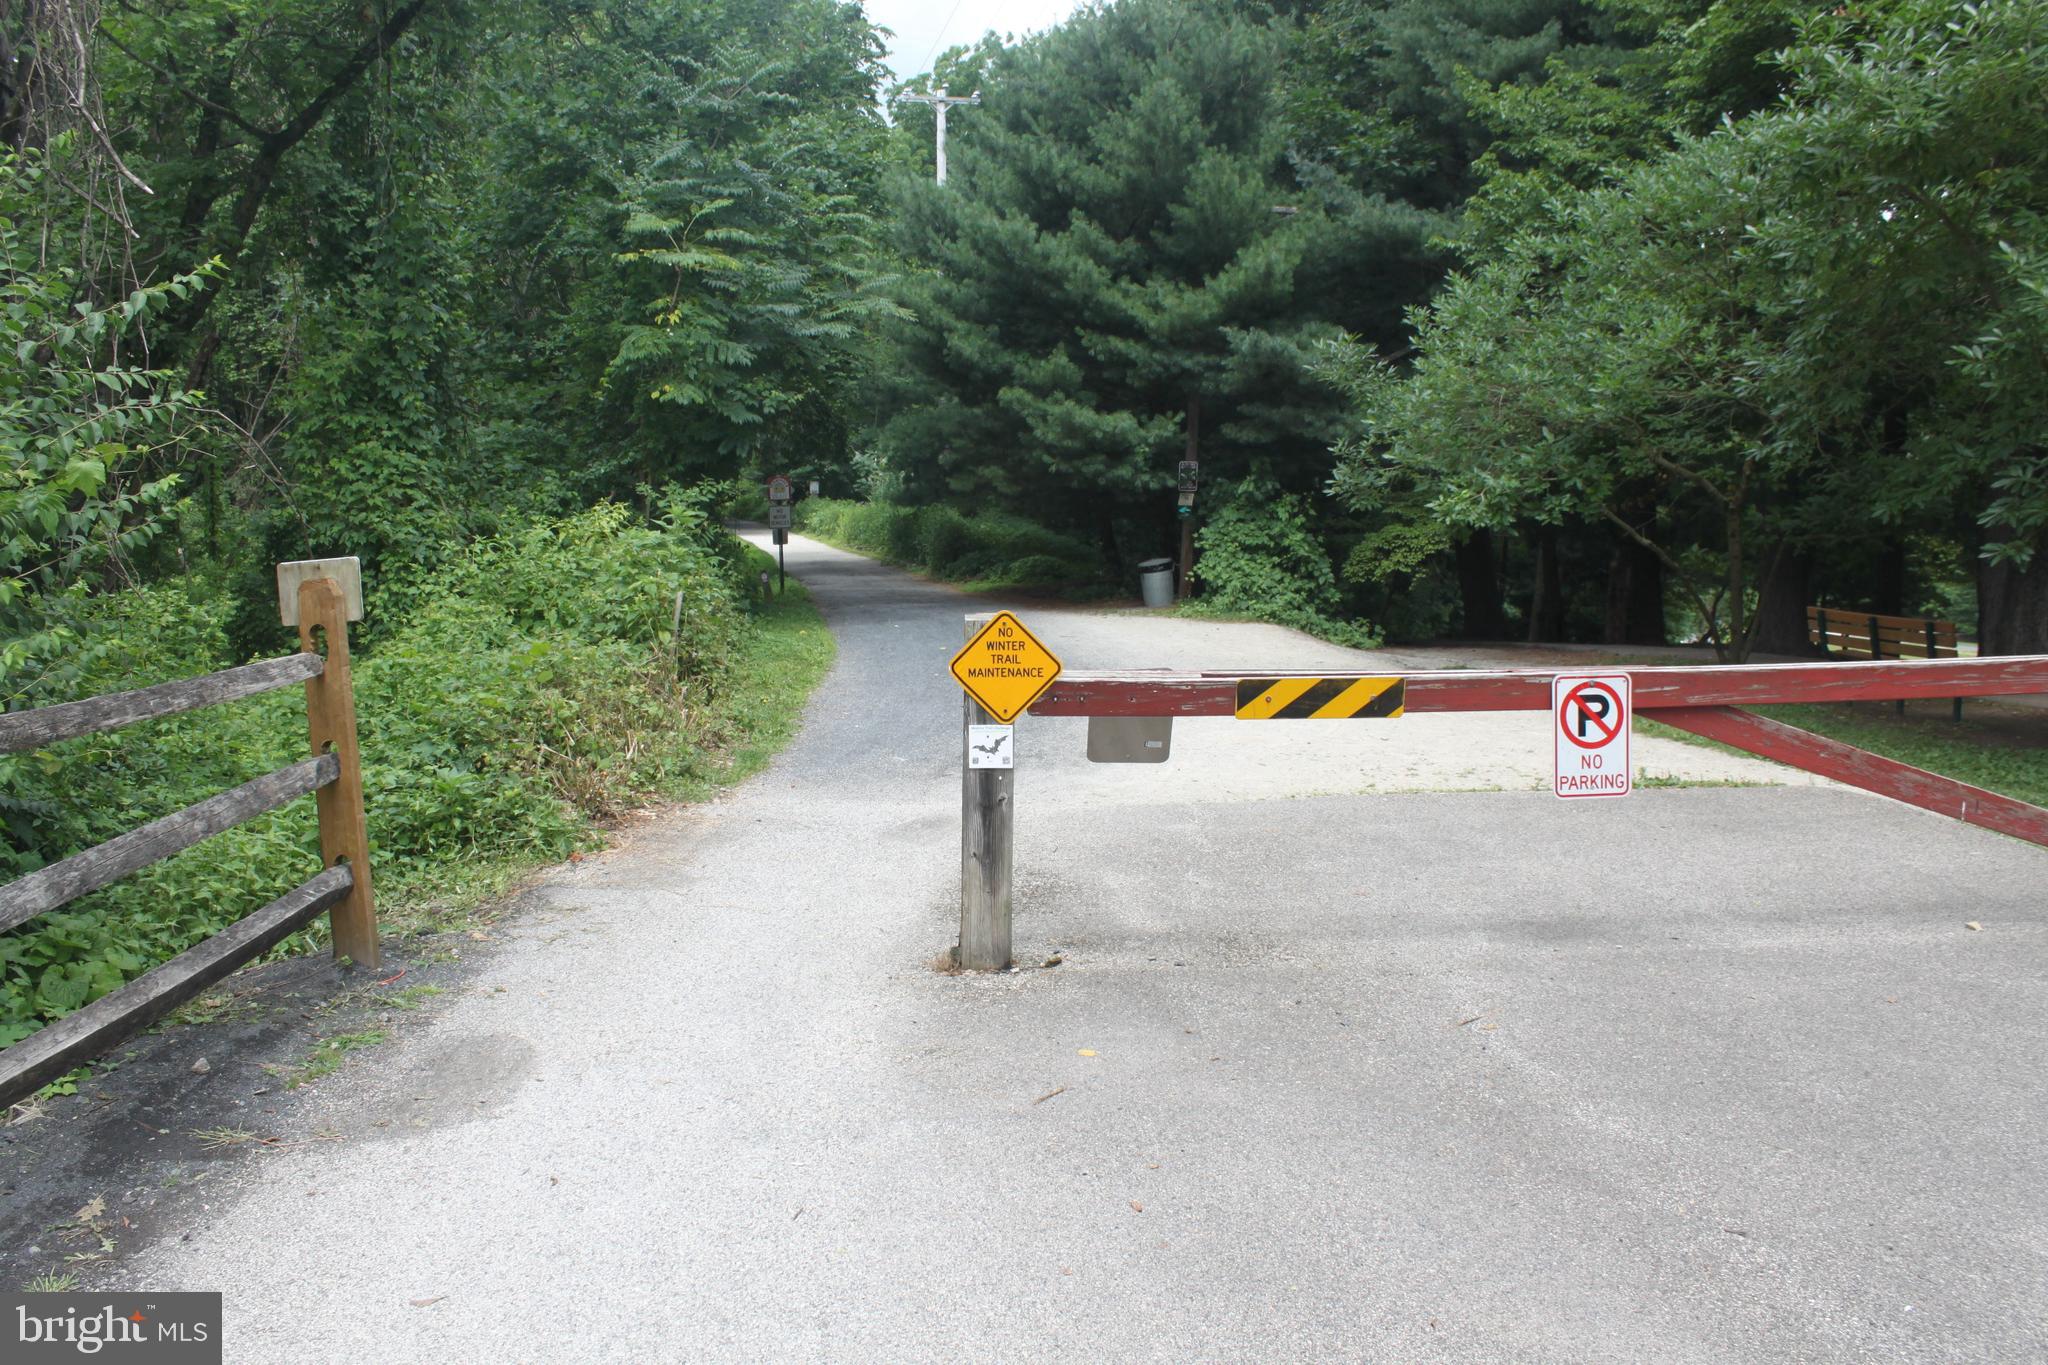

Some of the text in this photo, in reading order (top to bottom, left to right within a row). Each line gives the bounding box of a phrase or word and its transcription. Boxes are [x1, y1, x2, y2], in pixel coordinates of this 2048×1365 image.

[998, 627, 1013, 638] NO
[986, 641, 1026, 651] WINTER
[991, 654, 1021, 665] TRAIL
[968, 667, 1044, 678] MAINTENANCE
[1578, 694, 1610, 737] P
[1581, 754, 1603, 770] NO
[1560, 774, 1625, 791] PARKING
